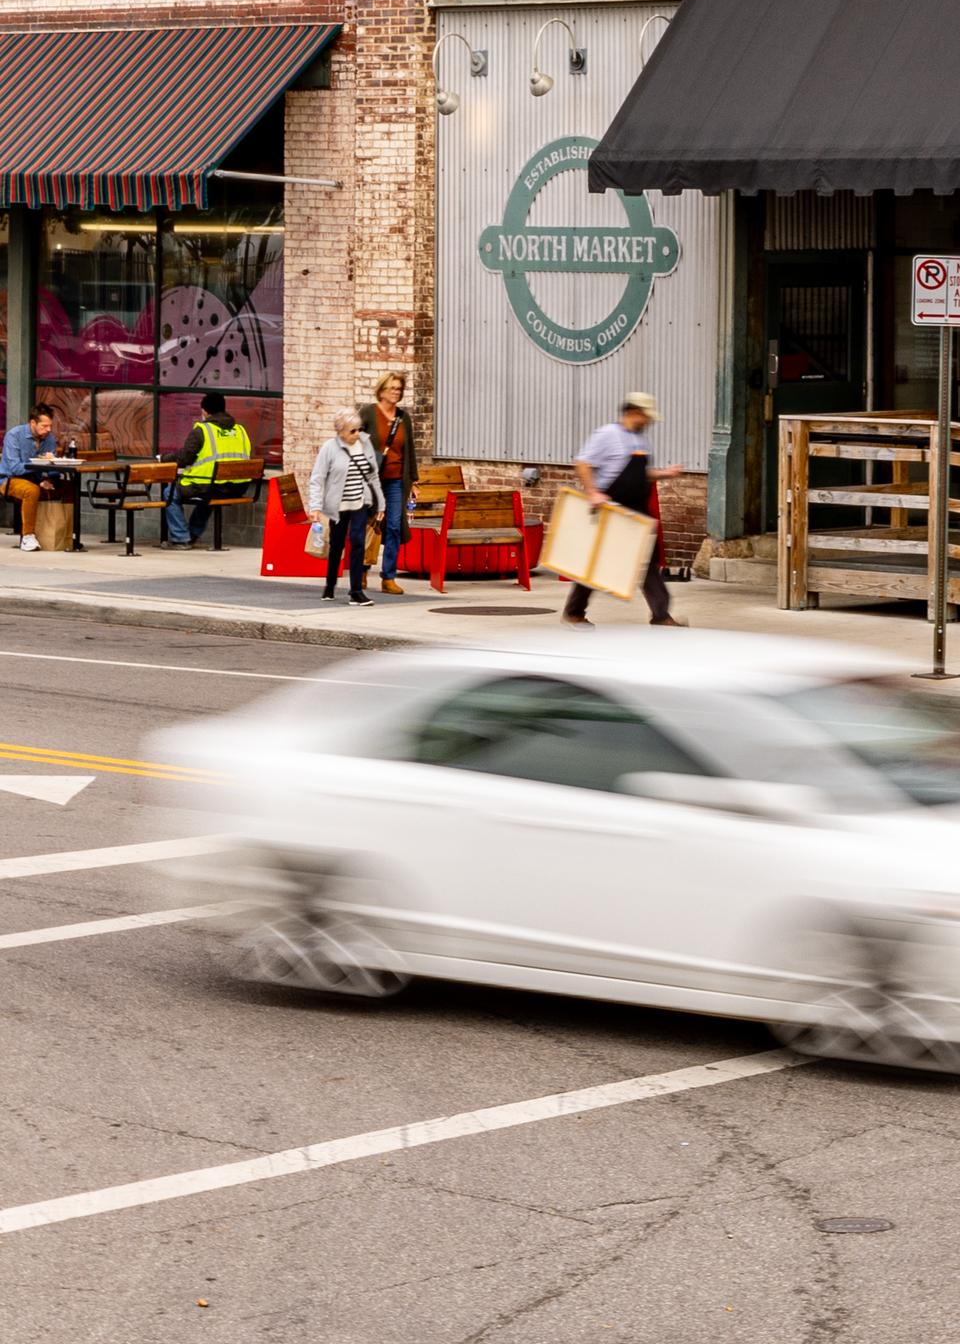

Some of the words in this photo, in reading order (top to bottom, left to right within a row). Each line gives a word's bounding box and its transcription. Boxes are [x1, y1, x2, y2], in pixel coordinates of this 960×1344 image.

[498, 234, 567, 262] NORTH
[573, 236, 656, 264] MARKET
[525, 310, 595, 352] COLUMBUS,
[597, 313, 629, 345] OHIO
